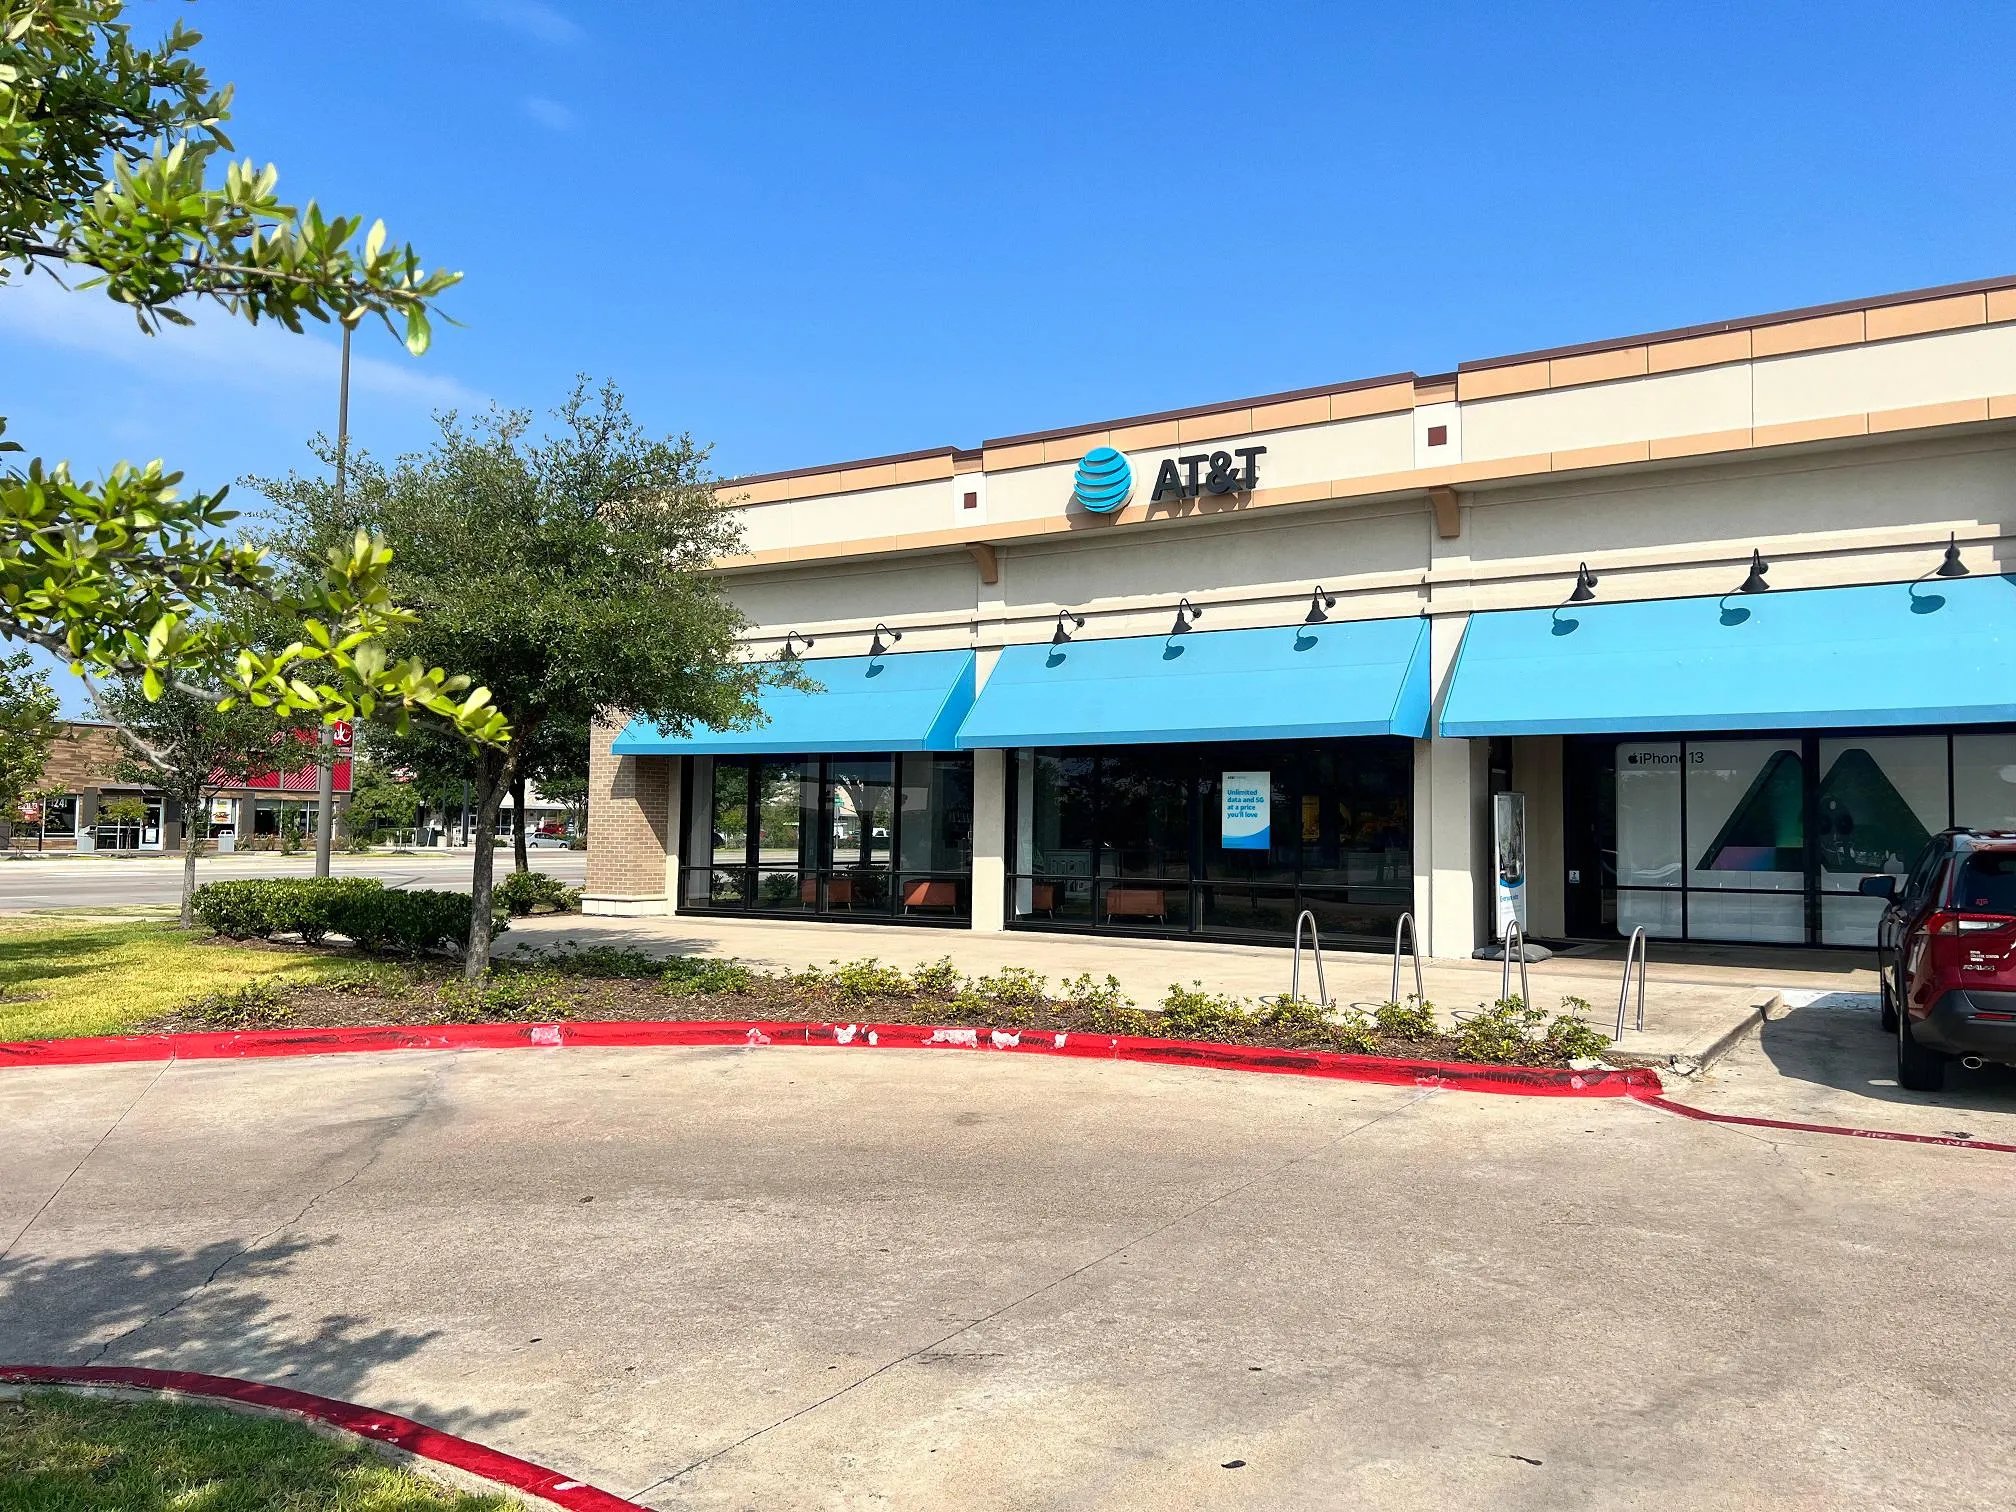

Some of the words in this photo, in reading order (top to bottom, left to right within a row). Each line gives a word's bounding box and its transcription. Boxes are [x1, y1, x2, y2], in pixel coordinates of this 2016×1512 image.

[1151, 445, 1267, 501] AT&T
[1639, 753, 1683, 764] iPhon
[1689, 751, 1704, 764] 13
[1240, 804, 1256, 812] price
